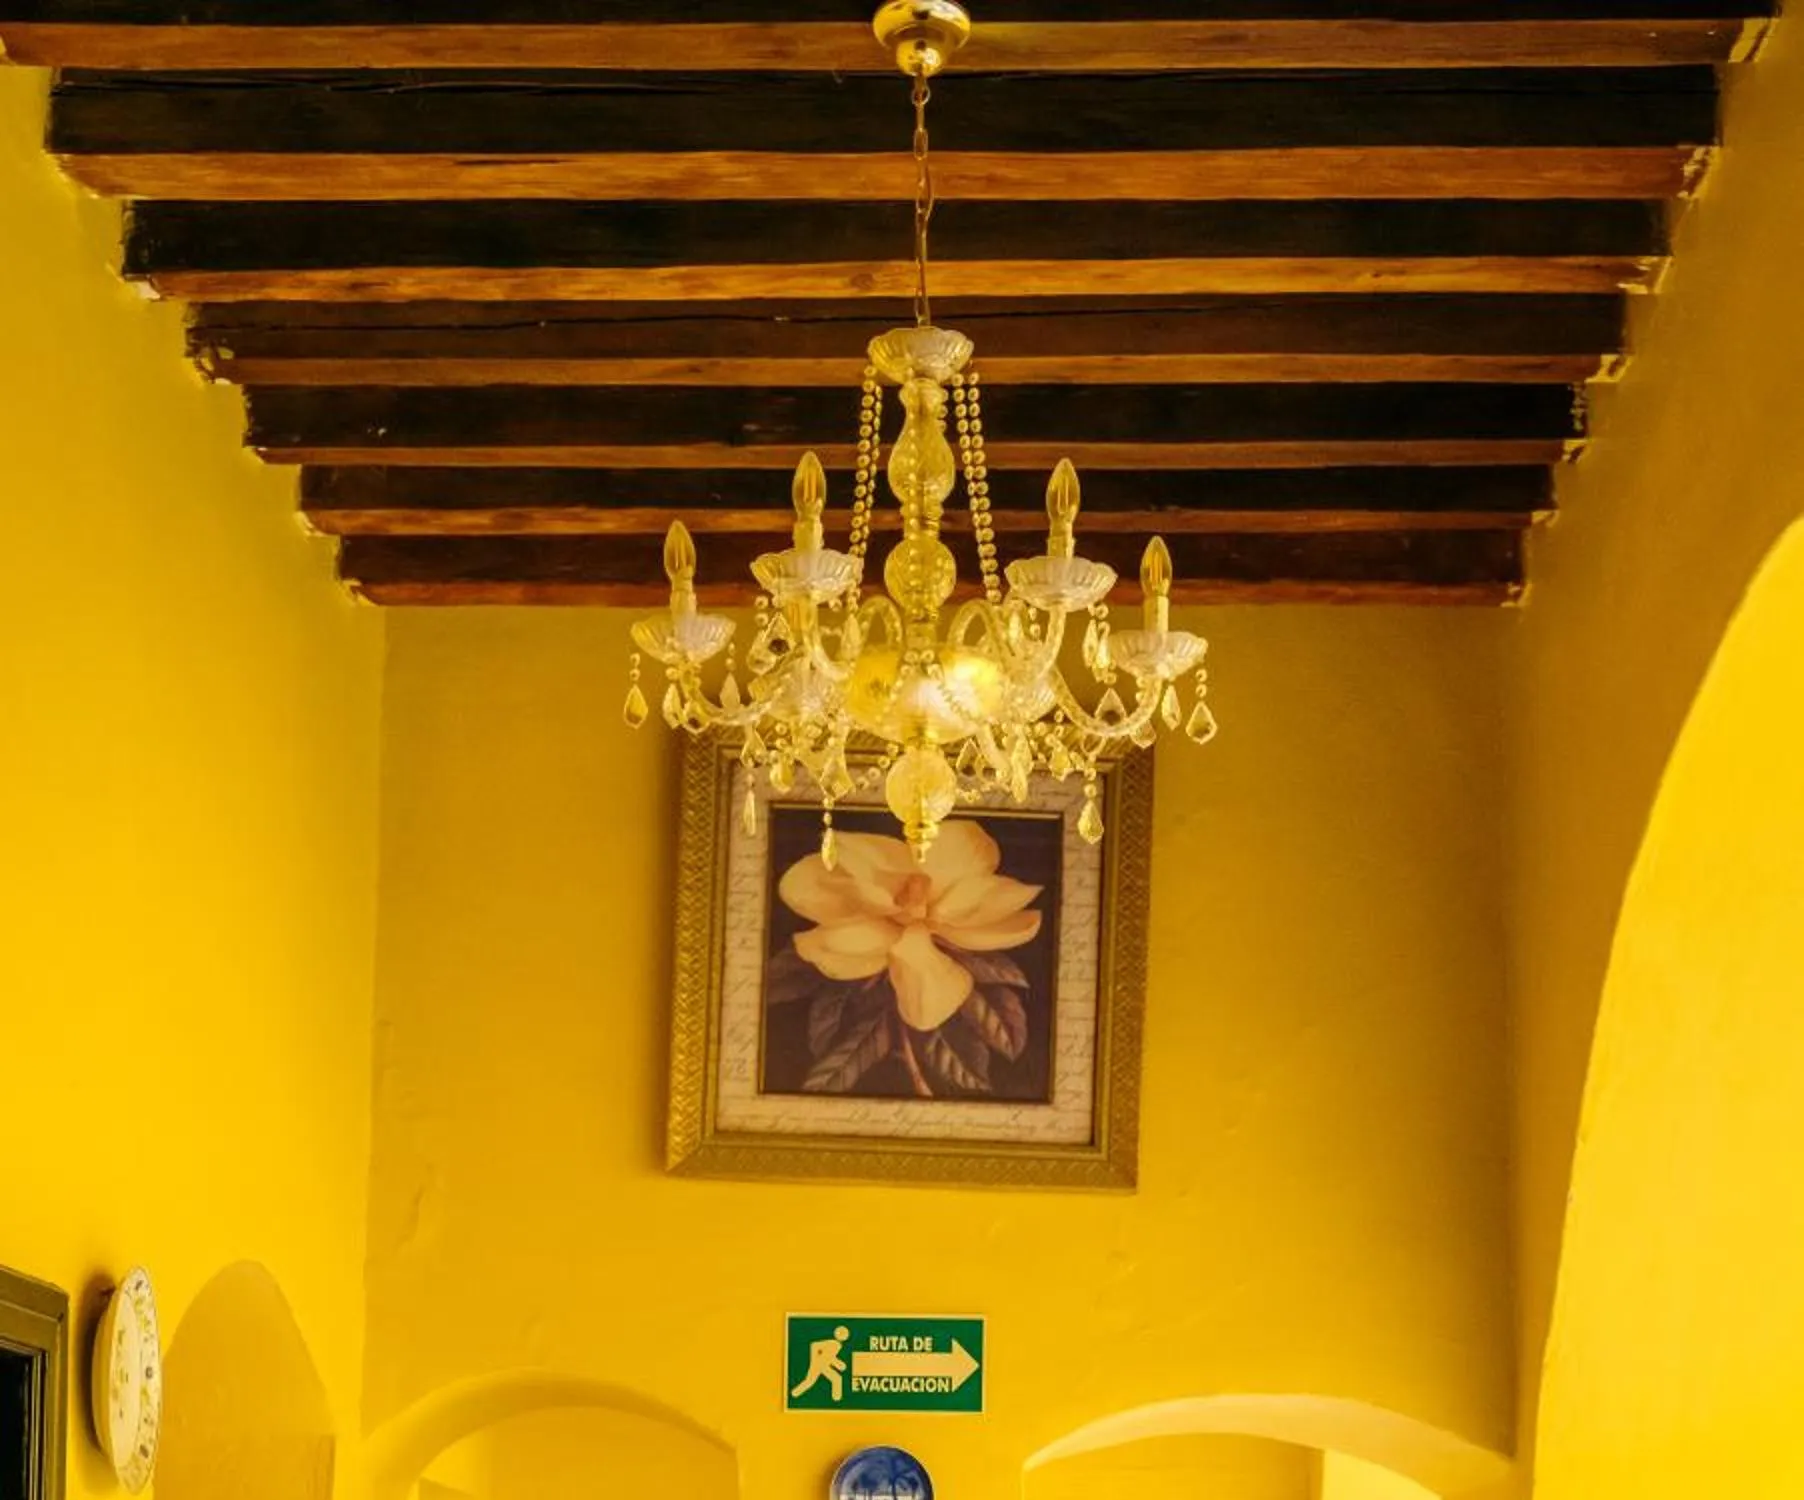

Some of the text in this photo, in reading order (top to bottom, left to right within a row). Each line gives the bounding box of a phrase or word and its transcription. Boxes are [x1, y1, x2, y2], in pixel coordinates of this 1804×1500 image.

[869, 1335, 933, 1352] RUTA DE
[852, 1377, 950, 1393] EVACUACION
